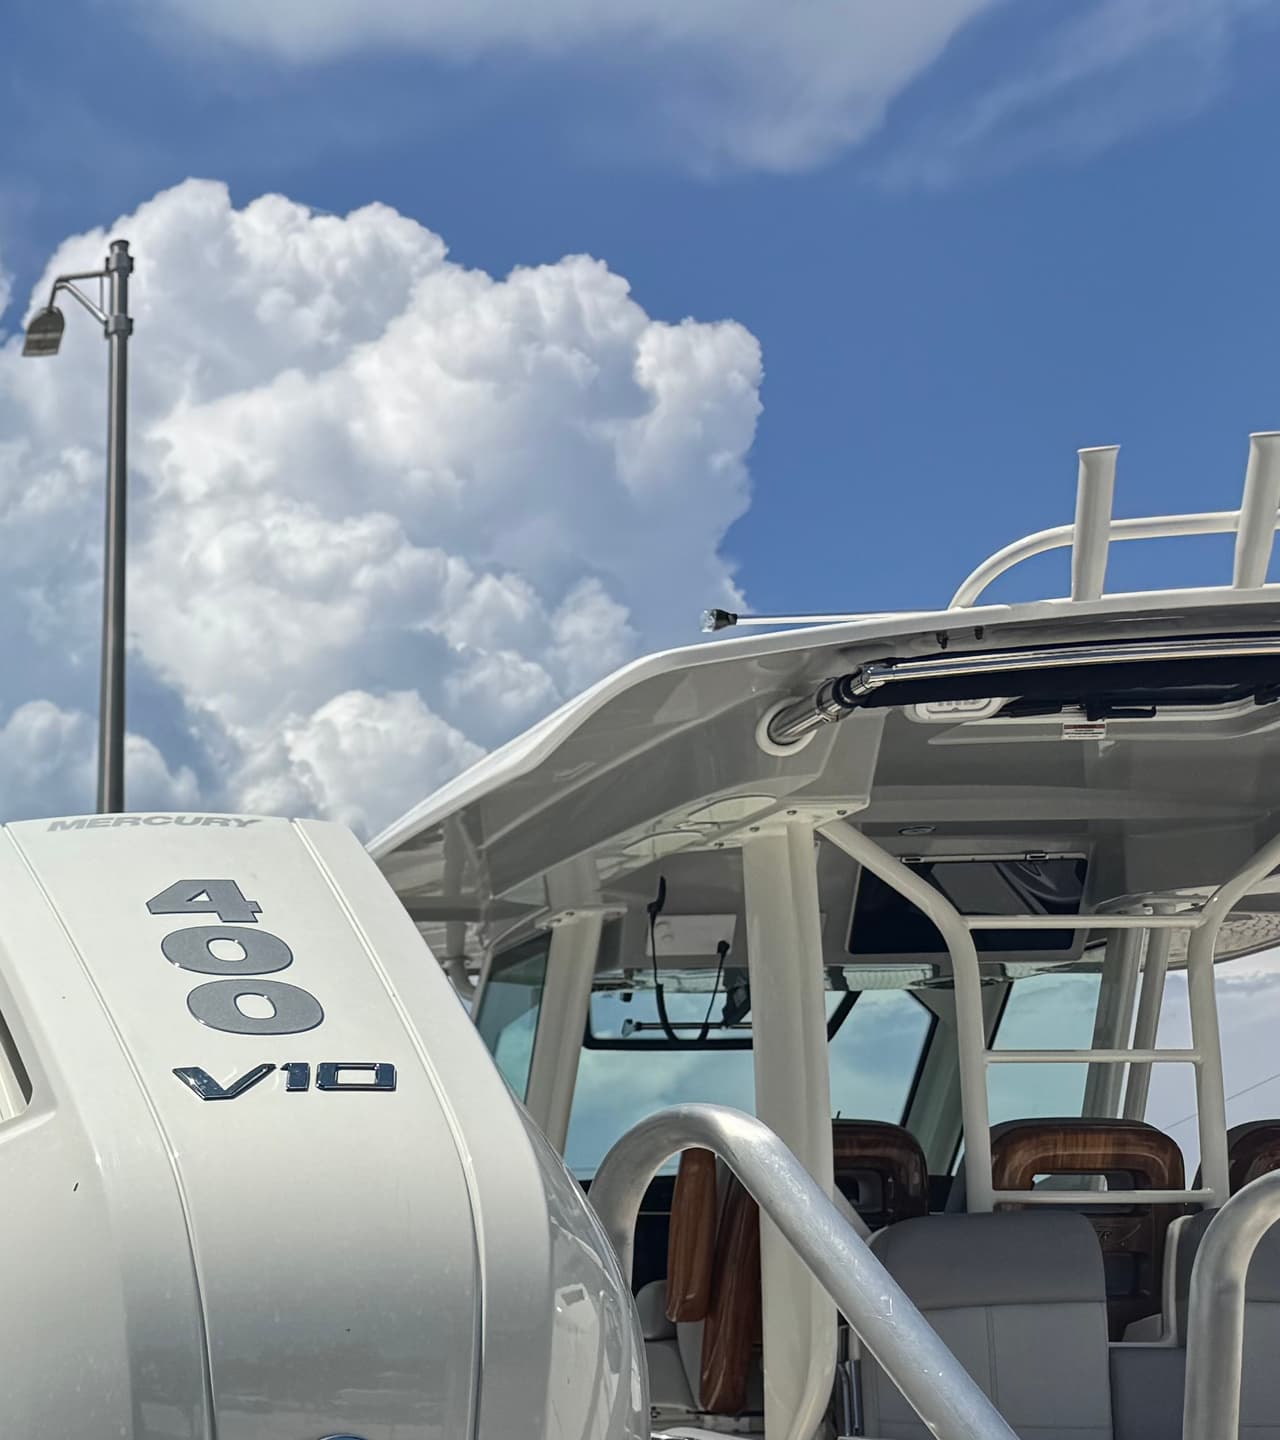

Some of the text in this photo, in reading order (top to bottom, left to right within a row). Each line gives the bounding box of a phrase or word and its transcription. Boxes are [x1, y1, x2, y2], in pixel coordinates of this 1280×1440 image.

[47, 815, 262, 832] MERCURY
[145, 879, 325, 1036] 400
[173, 1061, 398, 1101] V10
